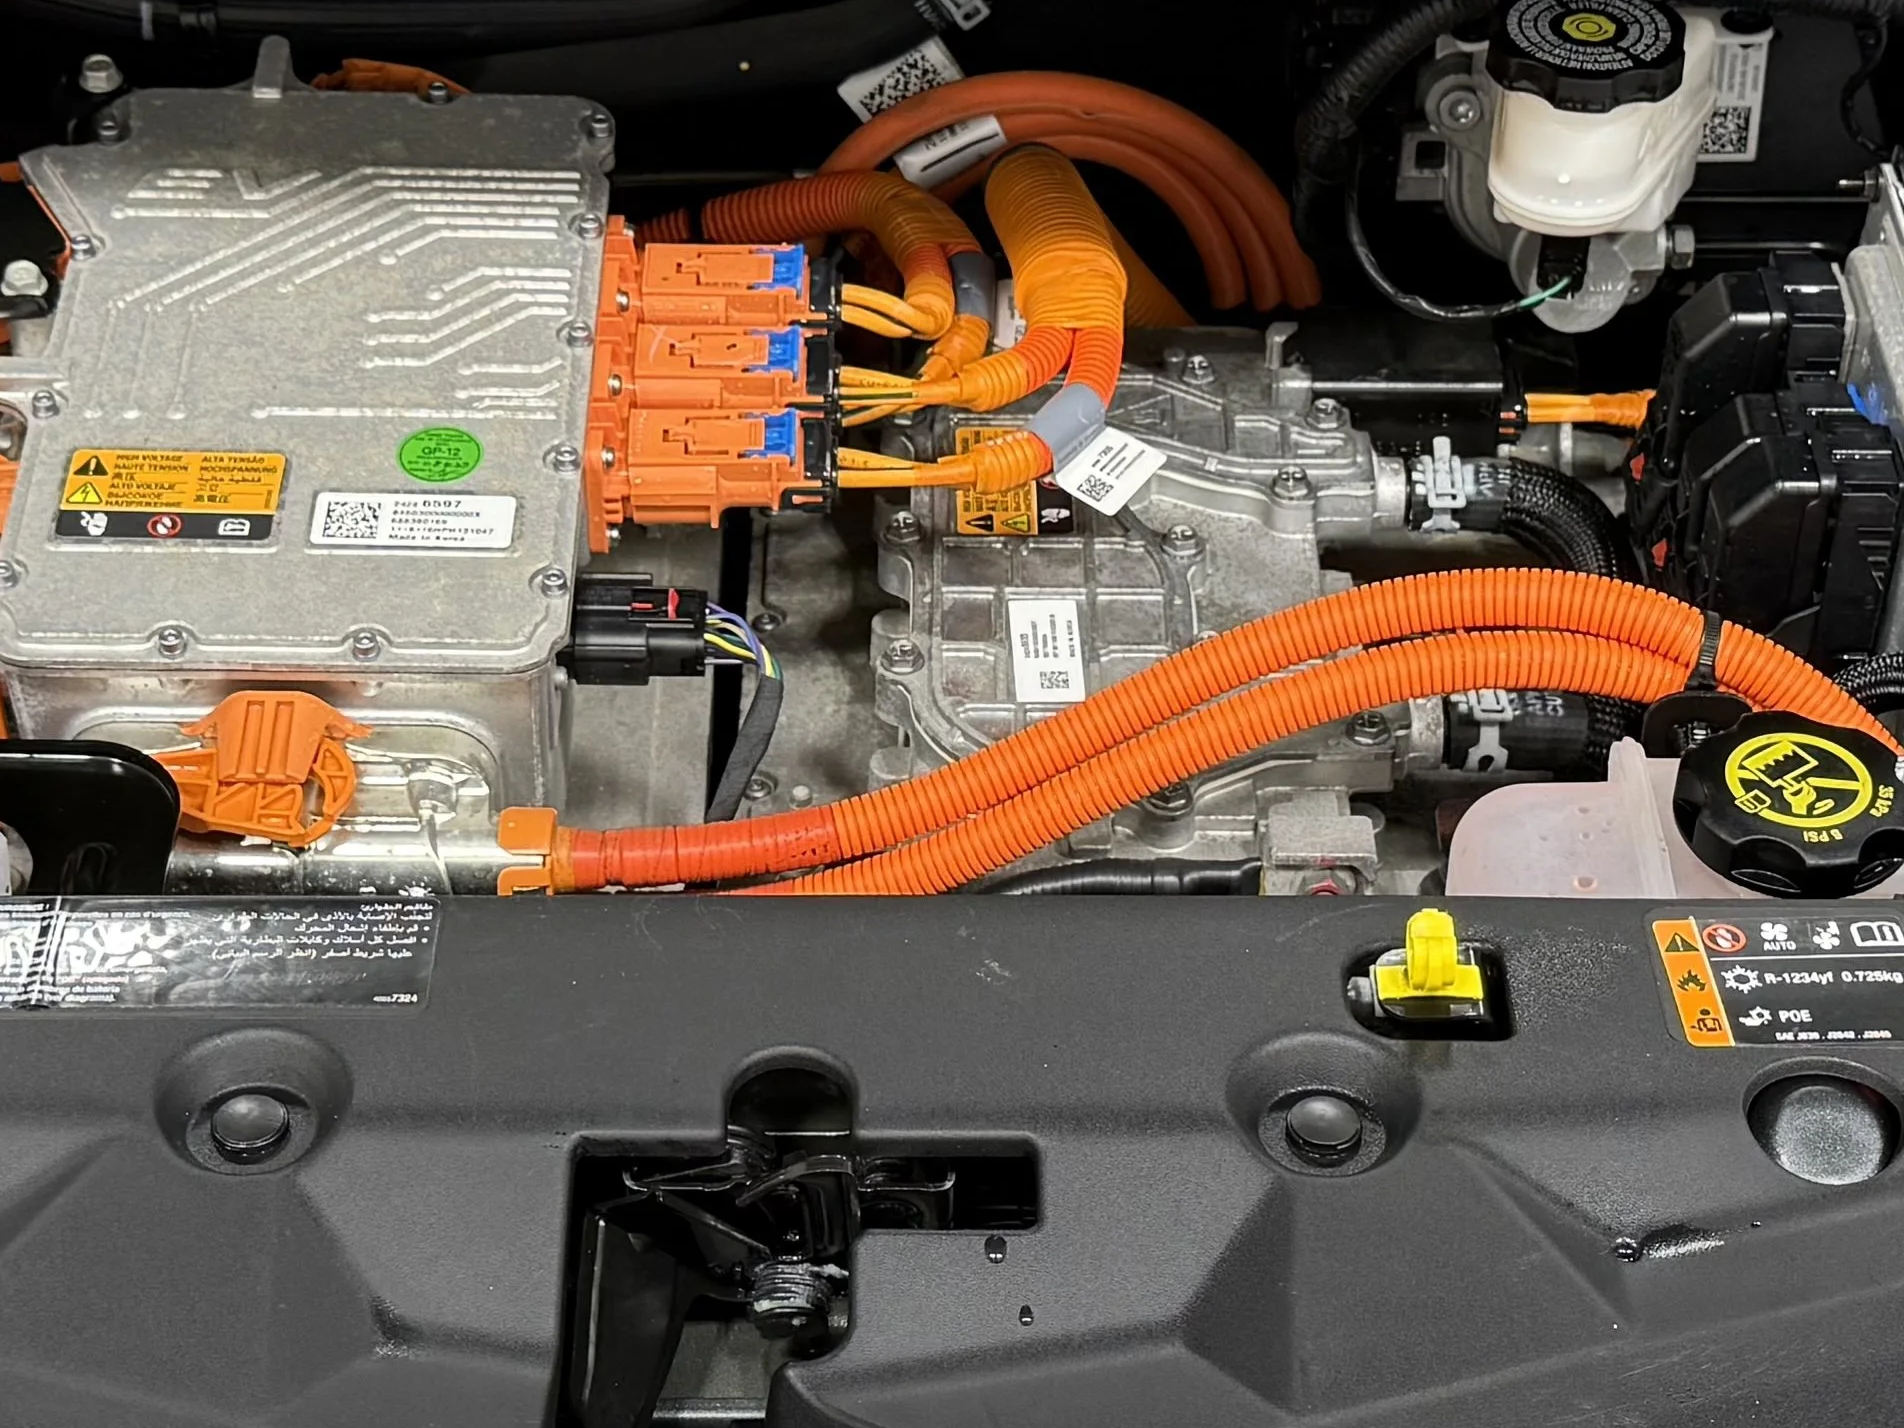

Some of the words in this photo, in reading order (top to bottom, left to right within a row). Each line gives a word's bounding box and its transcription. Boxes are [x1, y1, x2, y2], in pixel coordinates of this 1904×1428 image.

[421, 446, 462, 457] GP-12
[146, 454, 184, 462] VOLTAGE
[113, 462, 145, 471] HAUTE
[148, 463, 189, 471] TENSION
[1802, 830, 1830, 843] PSI
[1763, 941, 1797, 952] AUTO
[1763, 971, 1834, 986] R-1234yf
[1840, 970, 1904, 984] 0.725kg
[1778, 1009, 1813, 1023] POE
